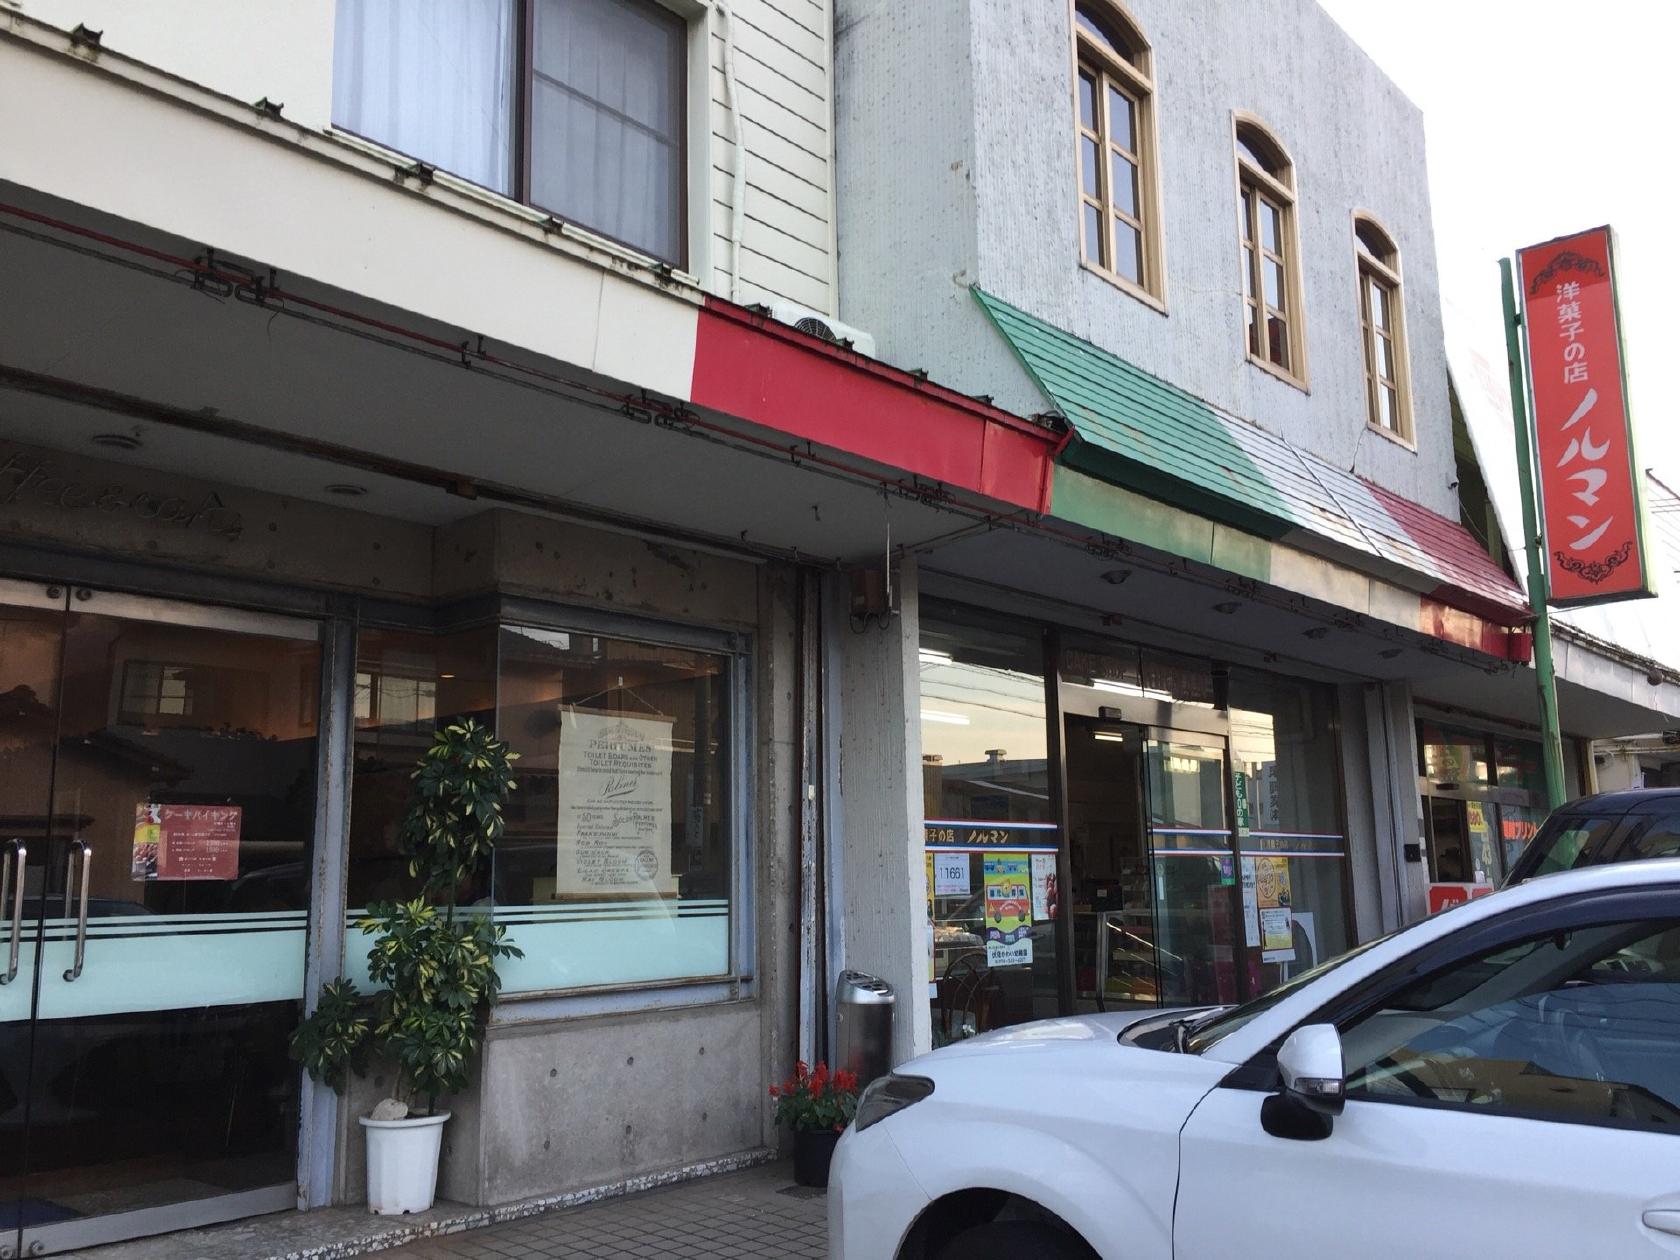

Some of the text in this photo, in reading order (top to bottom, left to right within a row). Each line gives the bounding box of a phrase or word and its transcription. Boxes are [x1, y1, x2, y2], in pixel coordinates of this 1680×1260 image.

[1556, 281, 1614, 551] 洋菓子の店 ノルマン
[164, 808, 239, 821] ケーキバイキング
[925, 828, 1009, 844] 子の店 ノルマン
